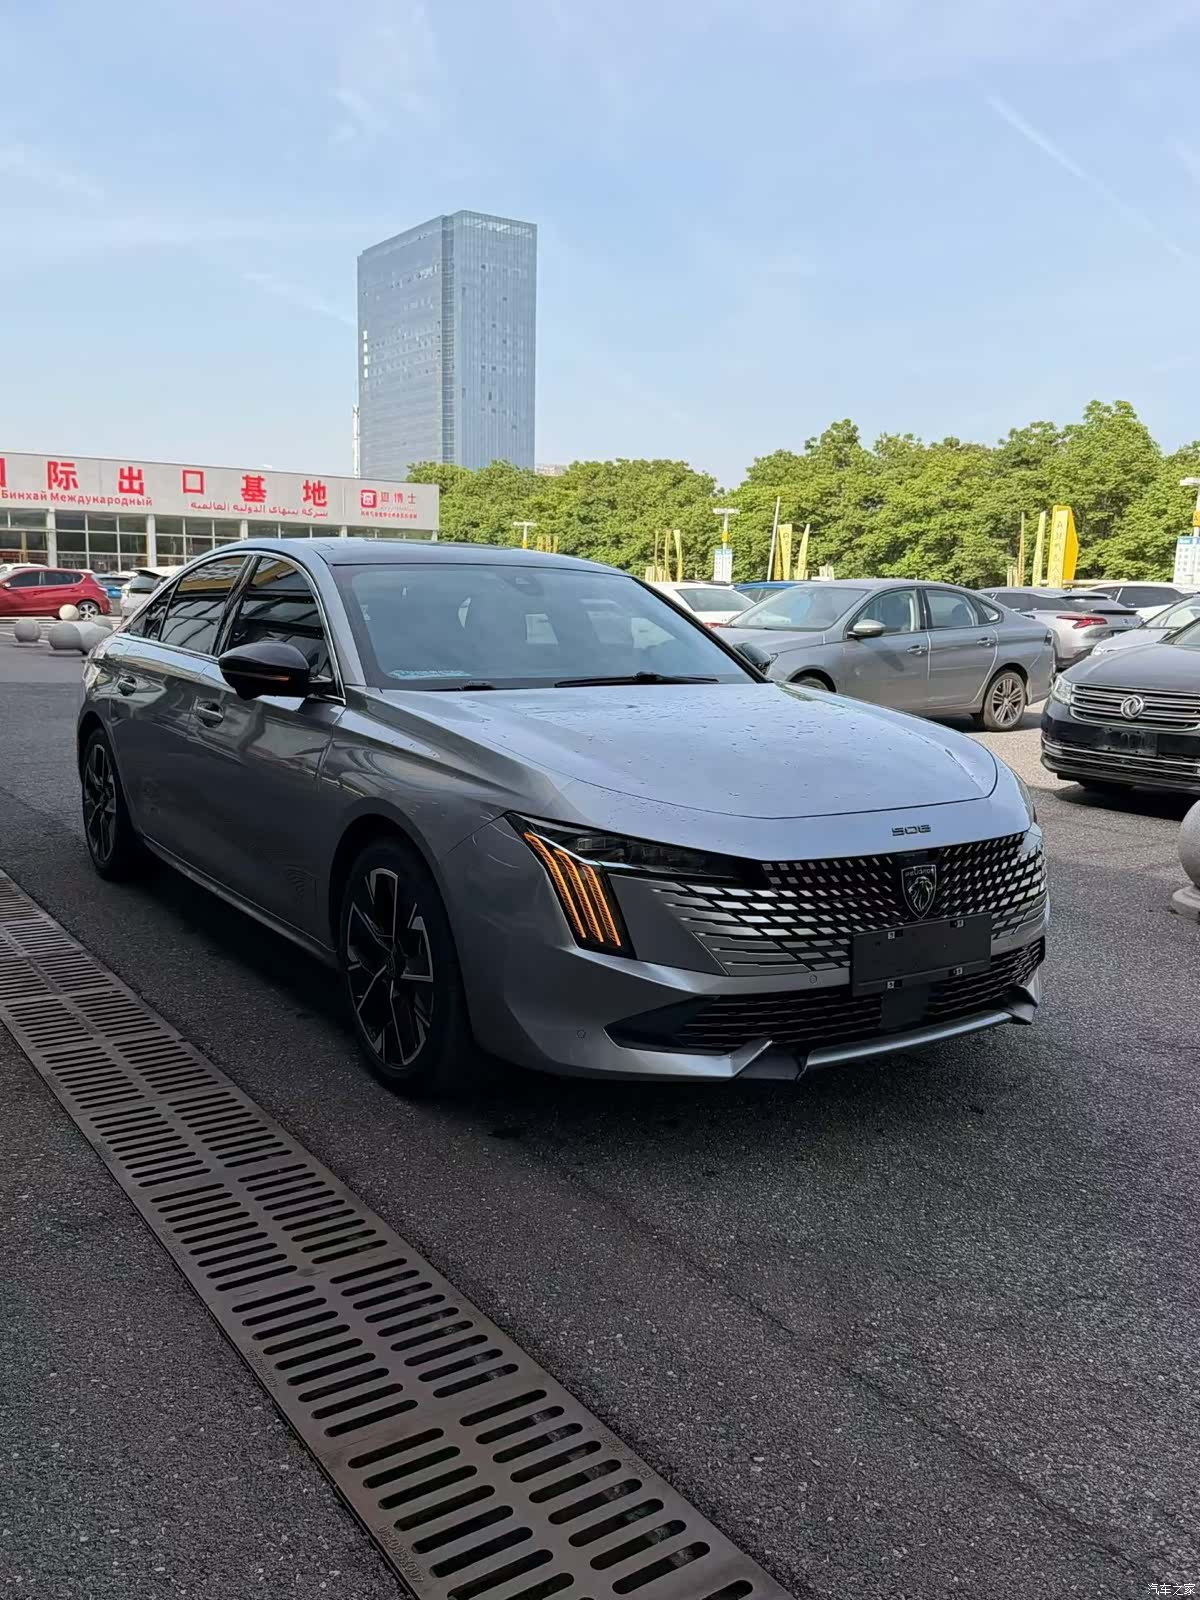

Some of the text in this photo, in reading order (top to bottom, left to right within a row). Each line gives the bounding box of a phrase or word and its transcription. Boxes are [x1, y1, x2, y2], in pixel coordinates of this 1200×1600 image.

[0, 457, 328, 508] 际出口基地
[1, 489, 153, 508] Бинхай Международный
